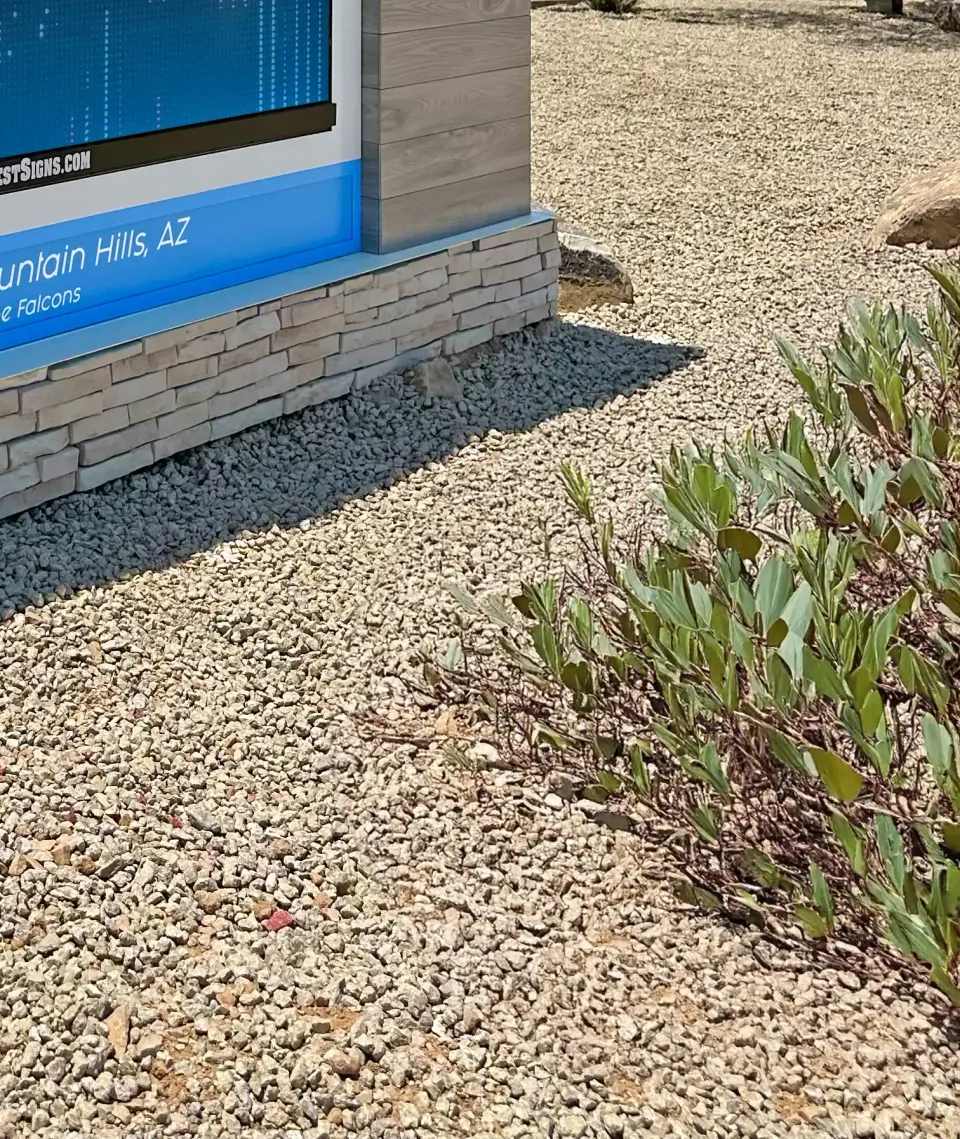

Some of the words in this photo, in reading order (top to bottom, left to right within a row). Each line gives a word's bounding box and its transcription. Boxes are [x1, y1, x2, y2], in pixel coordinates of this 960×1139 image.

[95, 229, 149, 266] Hills,
[157, 216, 191, 250] AZ
[17, 286, 81, 318] Falcons
